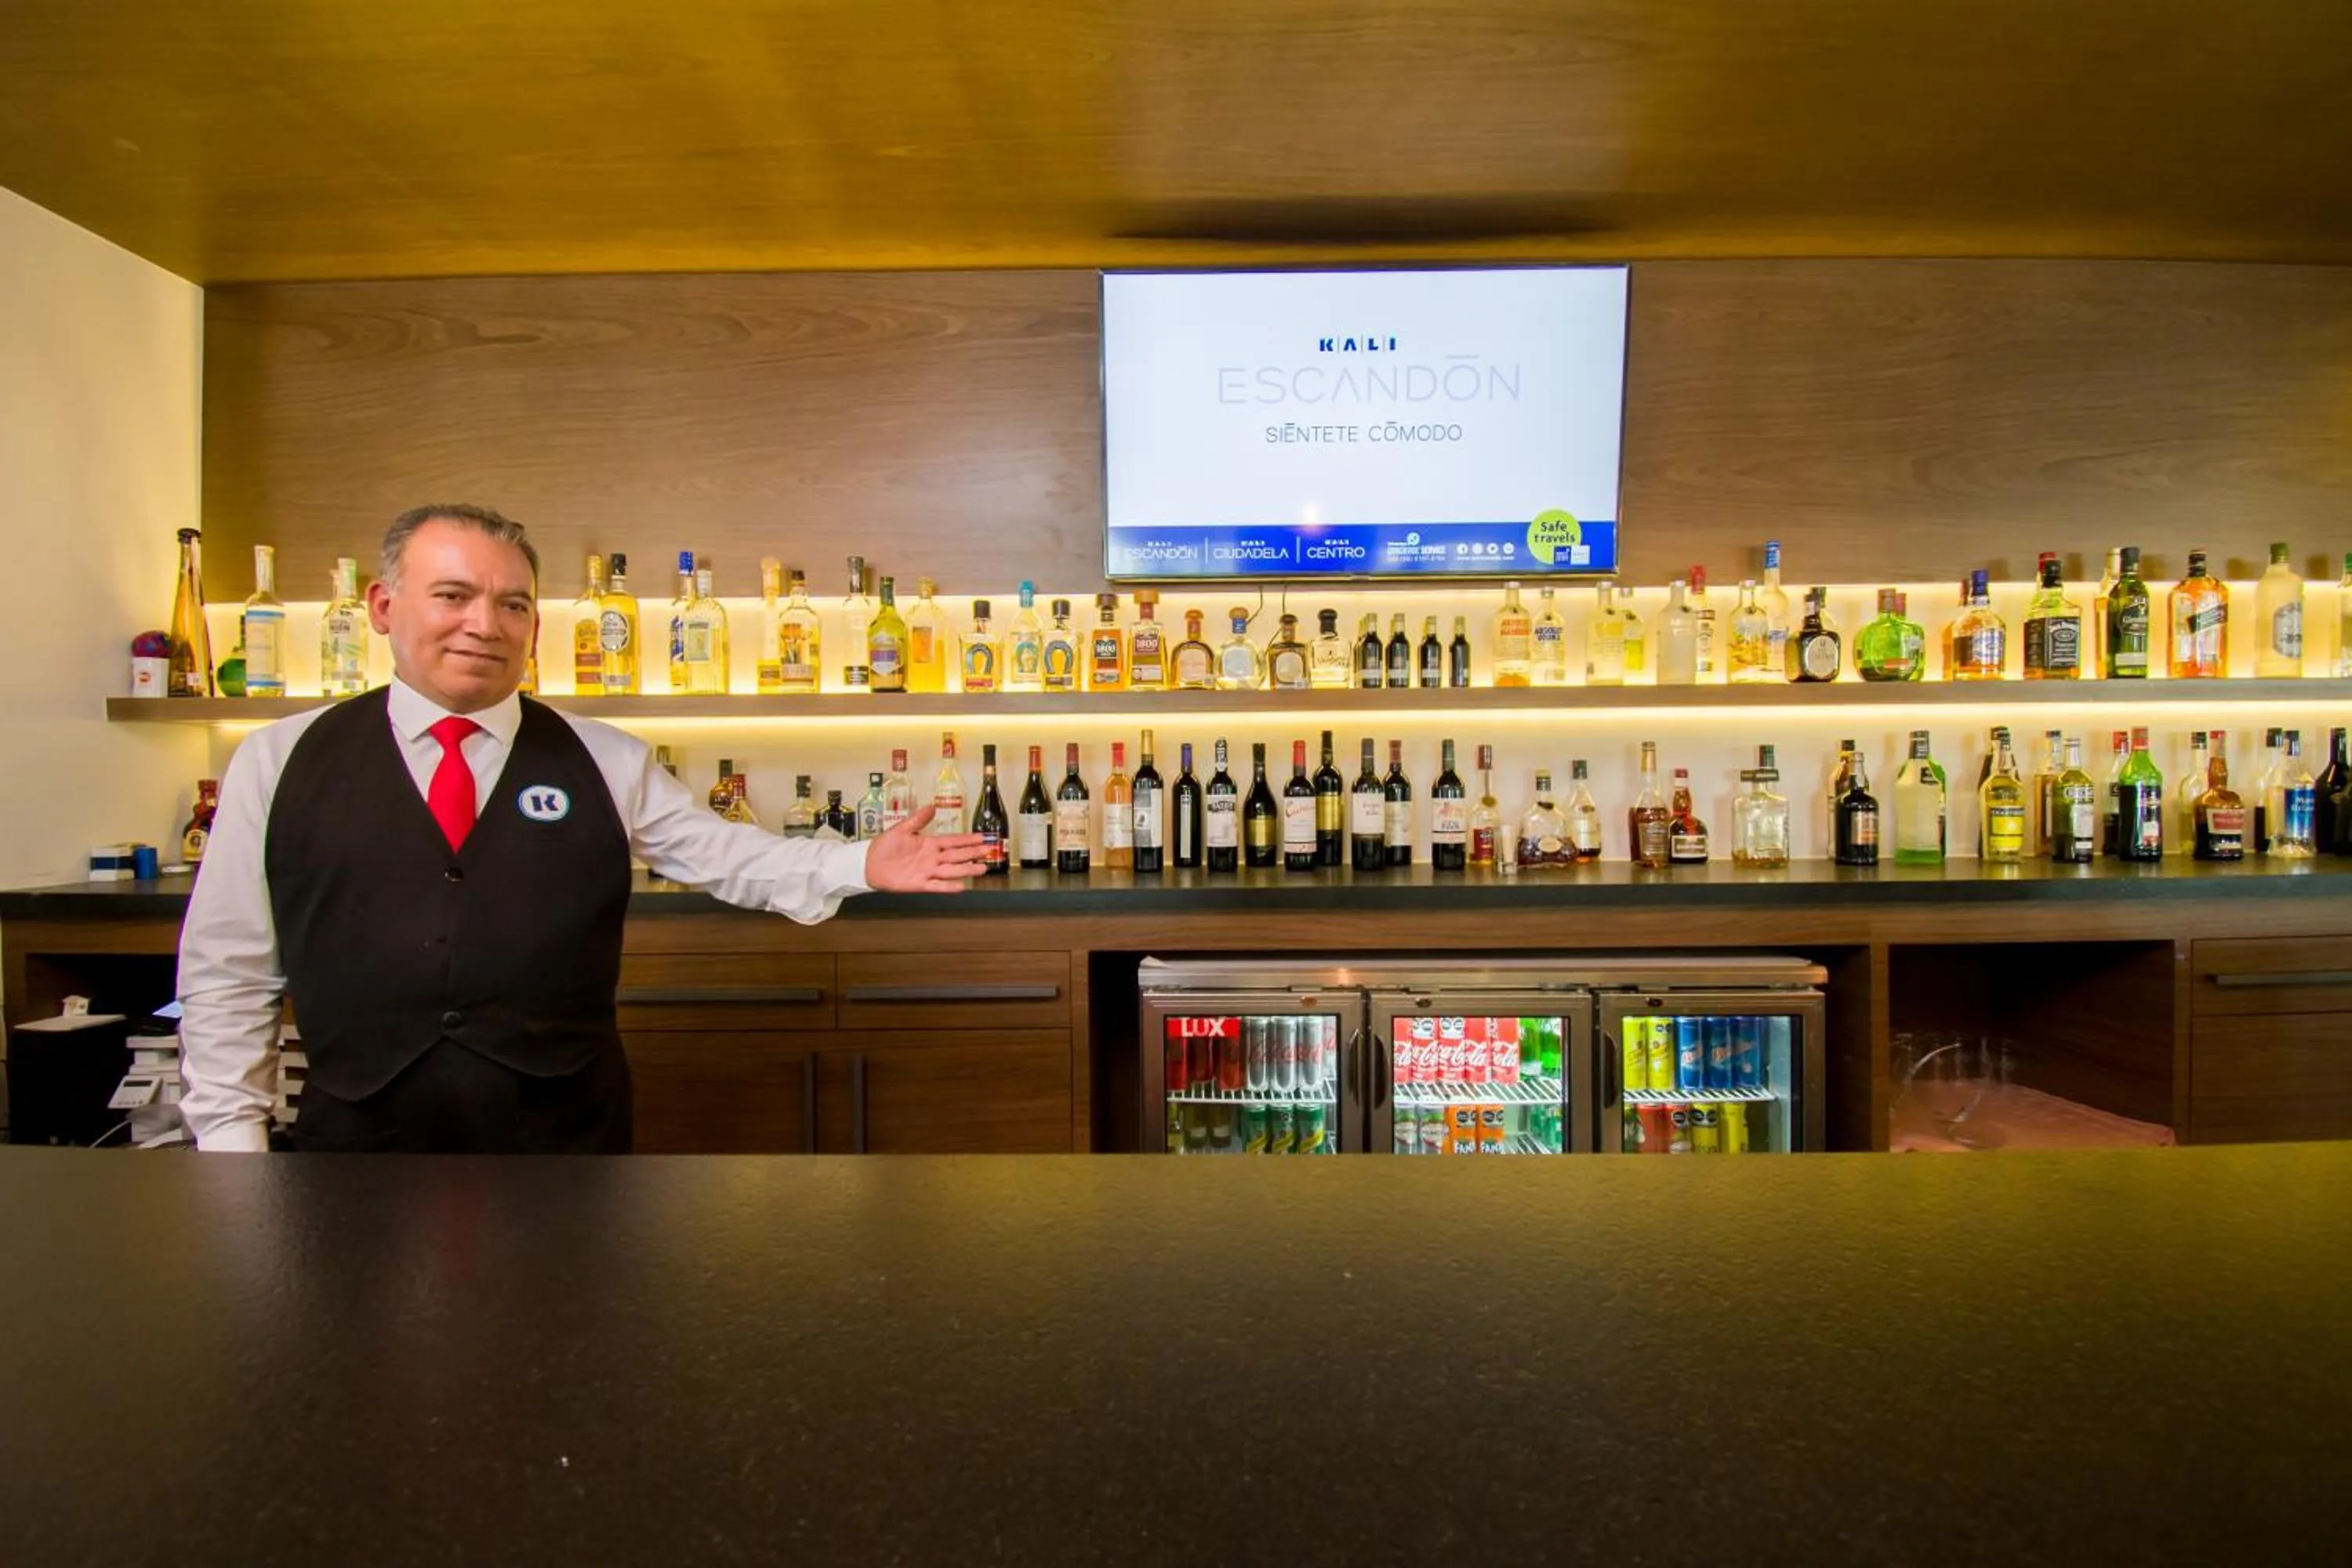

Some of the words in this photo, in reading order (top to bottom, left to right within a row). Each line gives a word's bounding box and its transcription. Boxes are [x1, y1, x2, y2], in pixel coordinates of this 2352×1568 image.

[1540, 520, 1567, 532] Safe
[1534, 532, 1575, 543] travels
[1213, 548, 1289, 560] CIUDADELA
[1306, 547, 1366, 560] CENTRO
[1136, 638, 1158, 649] 1800
[1181, 1018, 1225, 1037] LUX
